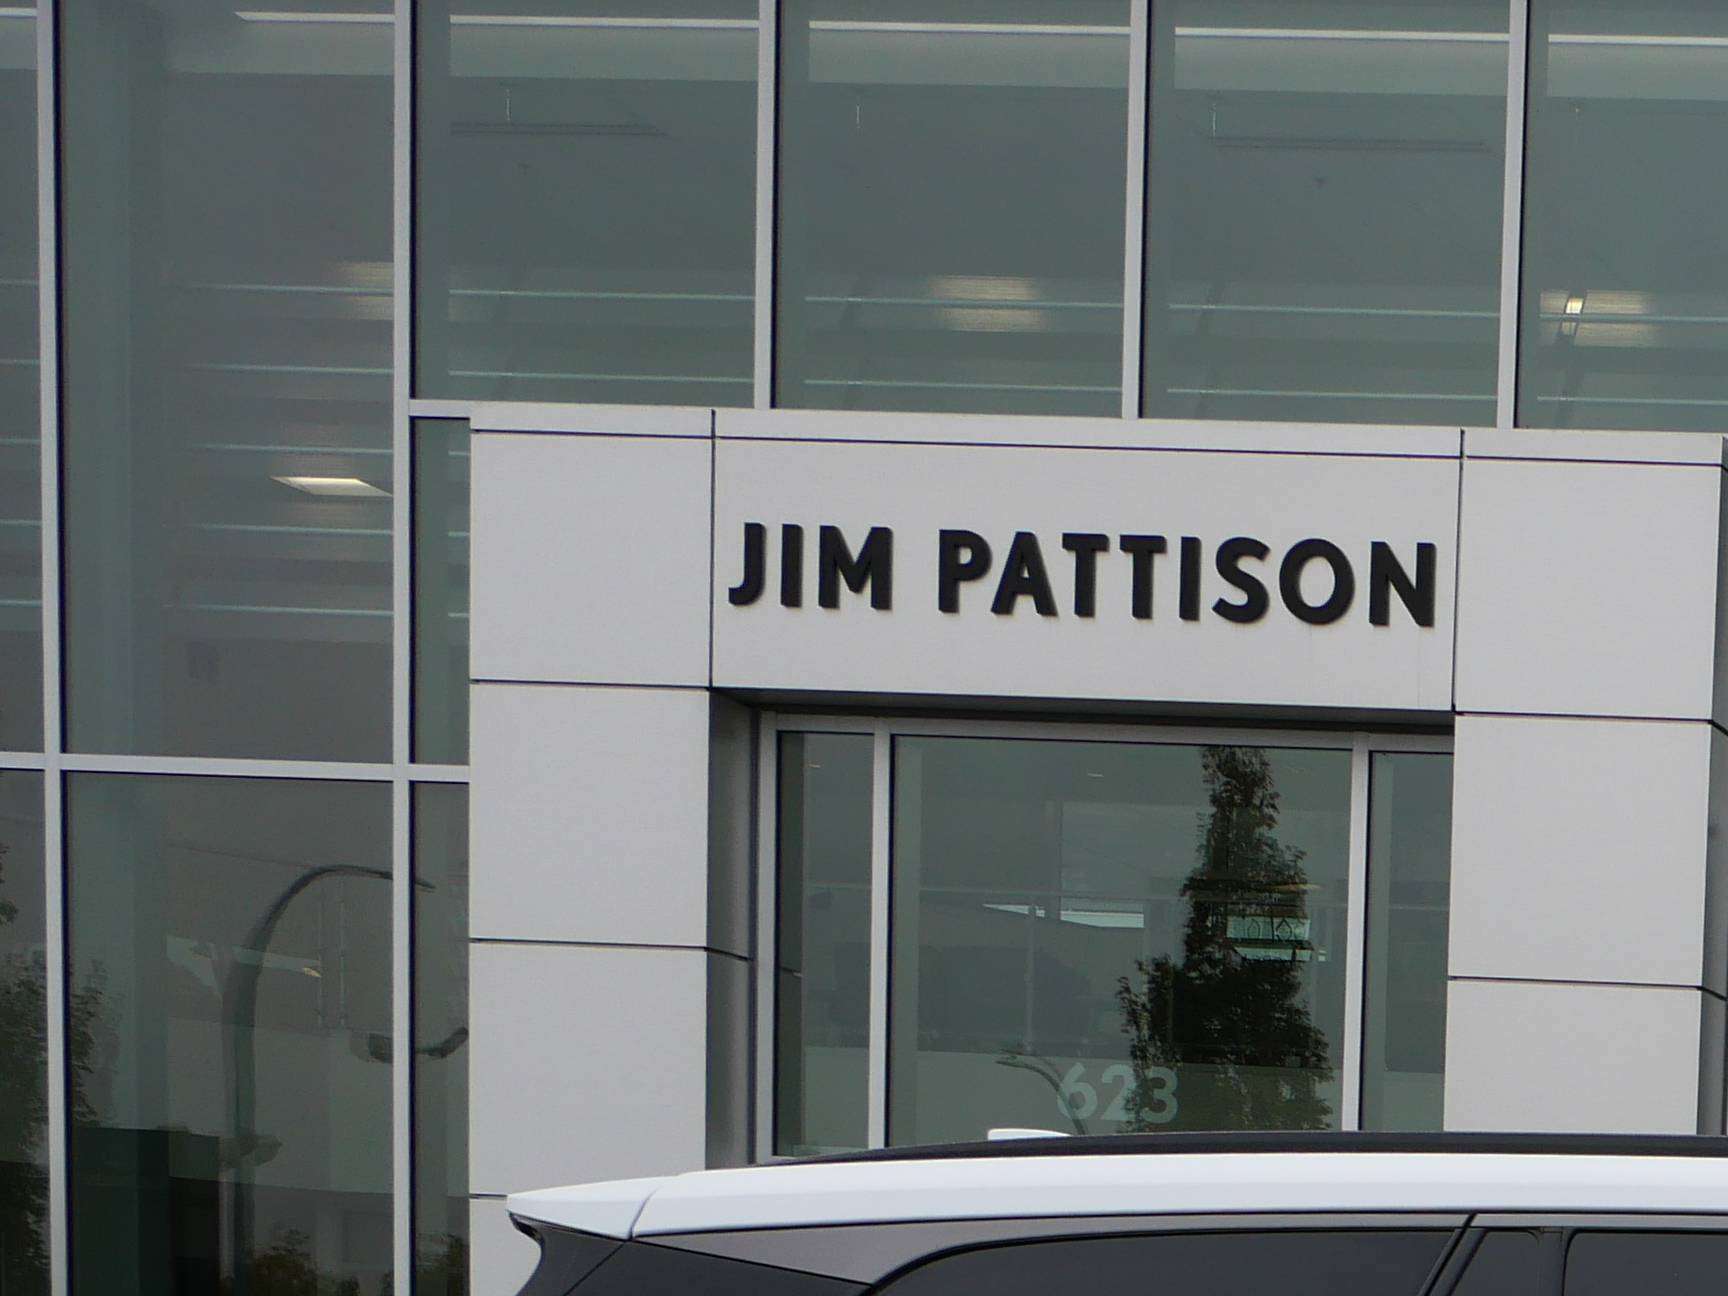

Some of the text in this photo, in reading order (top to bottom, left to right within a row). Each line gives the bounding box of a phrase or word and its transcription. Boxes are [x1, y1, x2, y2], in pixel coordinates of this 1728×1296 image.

[728, 521, 1438, 629] JIM PATTISON
[1057, 1062, 1179, 1124] 623
